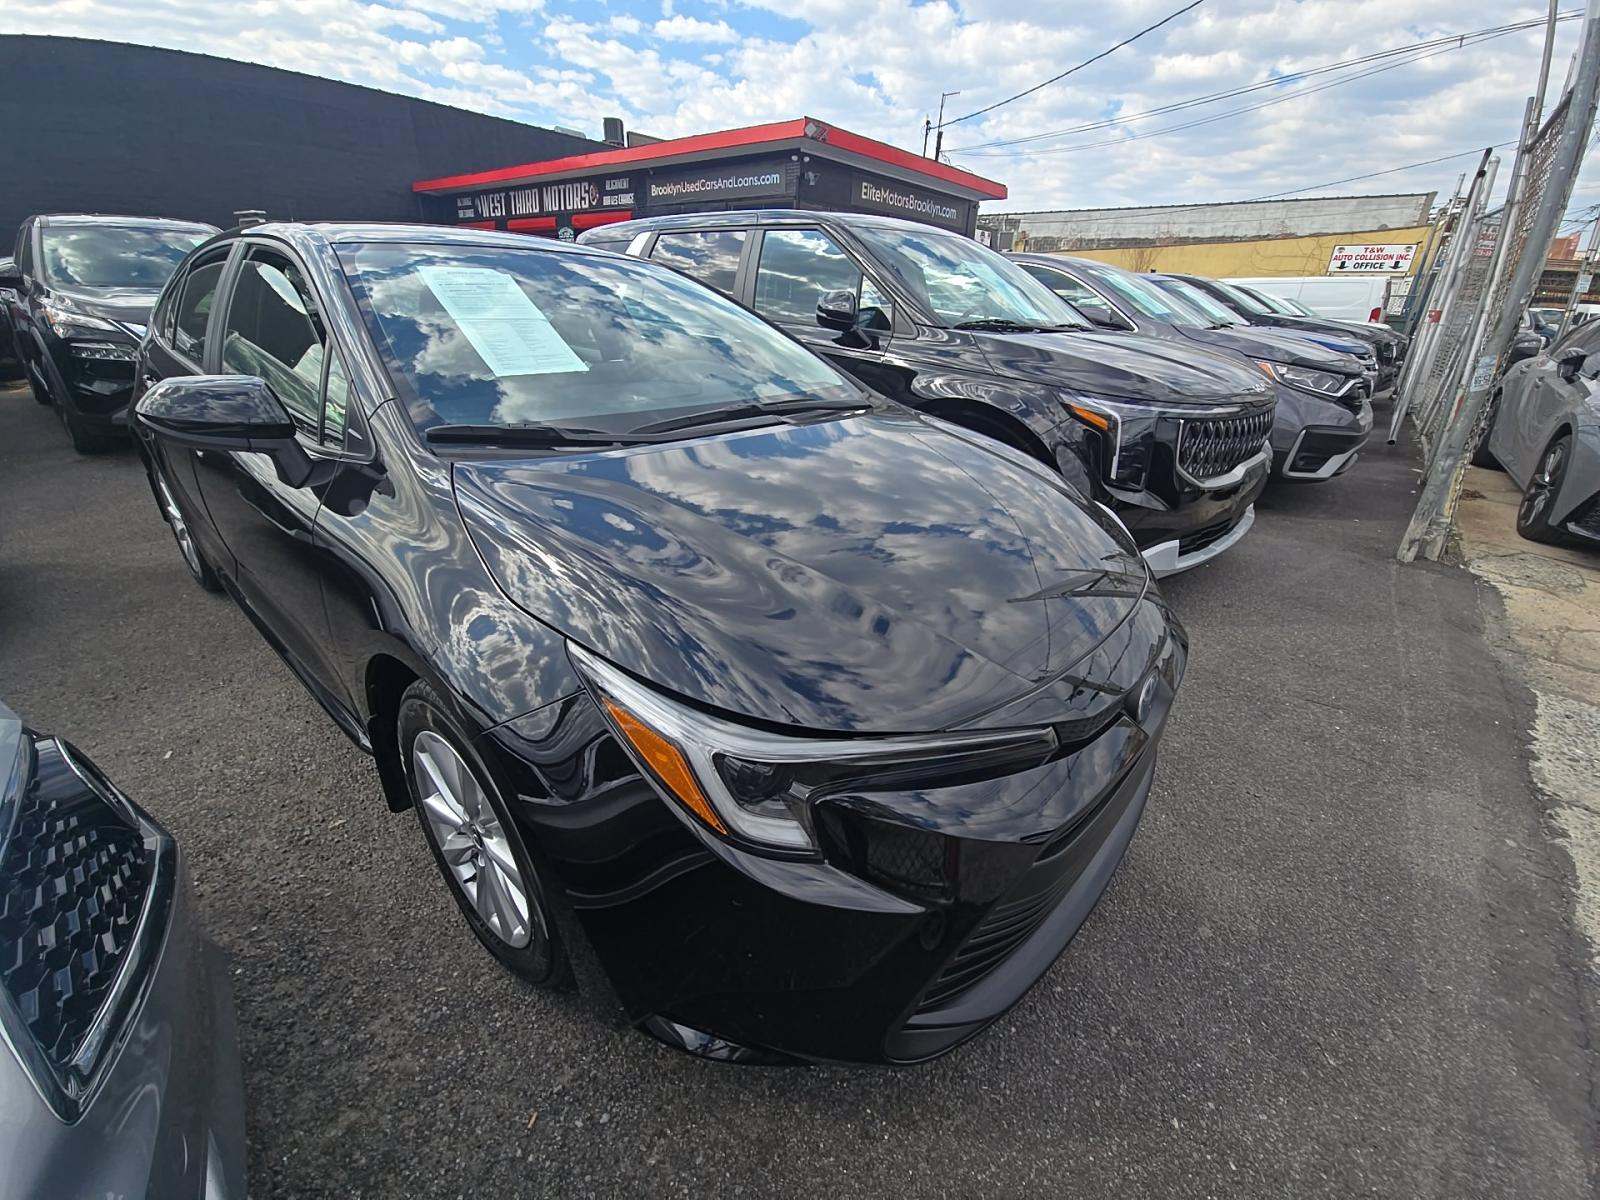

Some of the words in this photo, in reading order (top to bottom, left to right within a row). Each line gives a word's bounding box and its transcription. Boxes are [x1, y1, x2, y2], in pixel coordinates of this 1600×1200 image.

[651, 173, 780, 196] BrooklynUsedCarsAndLoans.com
[480, 192, 506, 218] WEST
[509, 188, 540, 215] THIRD
[543, 182, 590, 212] MOTORS
[861, 182, 957, 219] EliteMotorsBrooklyn.com
[1353, 262, 1385, 270] OFFICE
